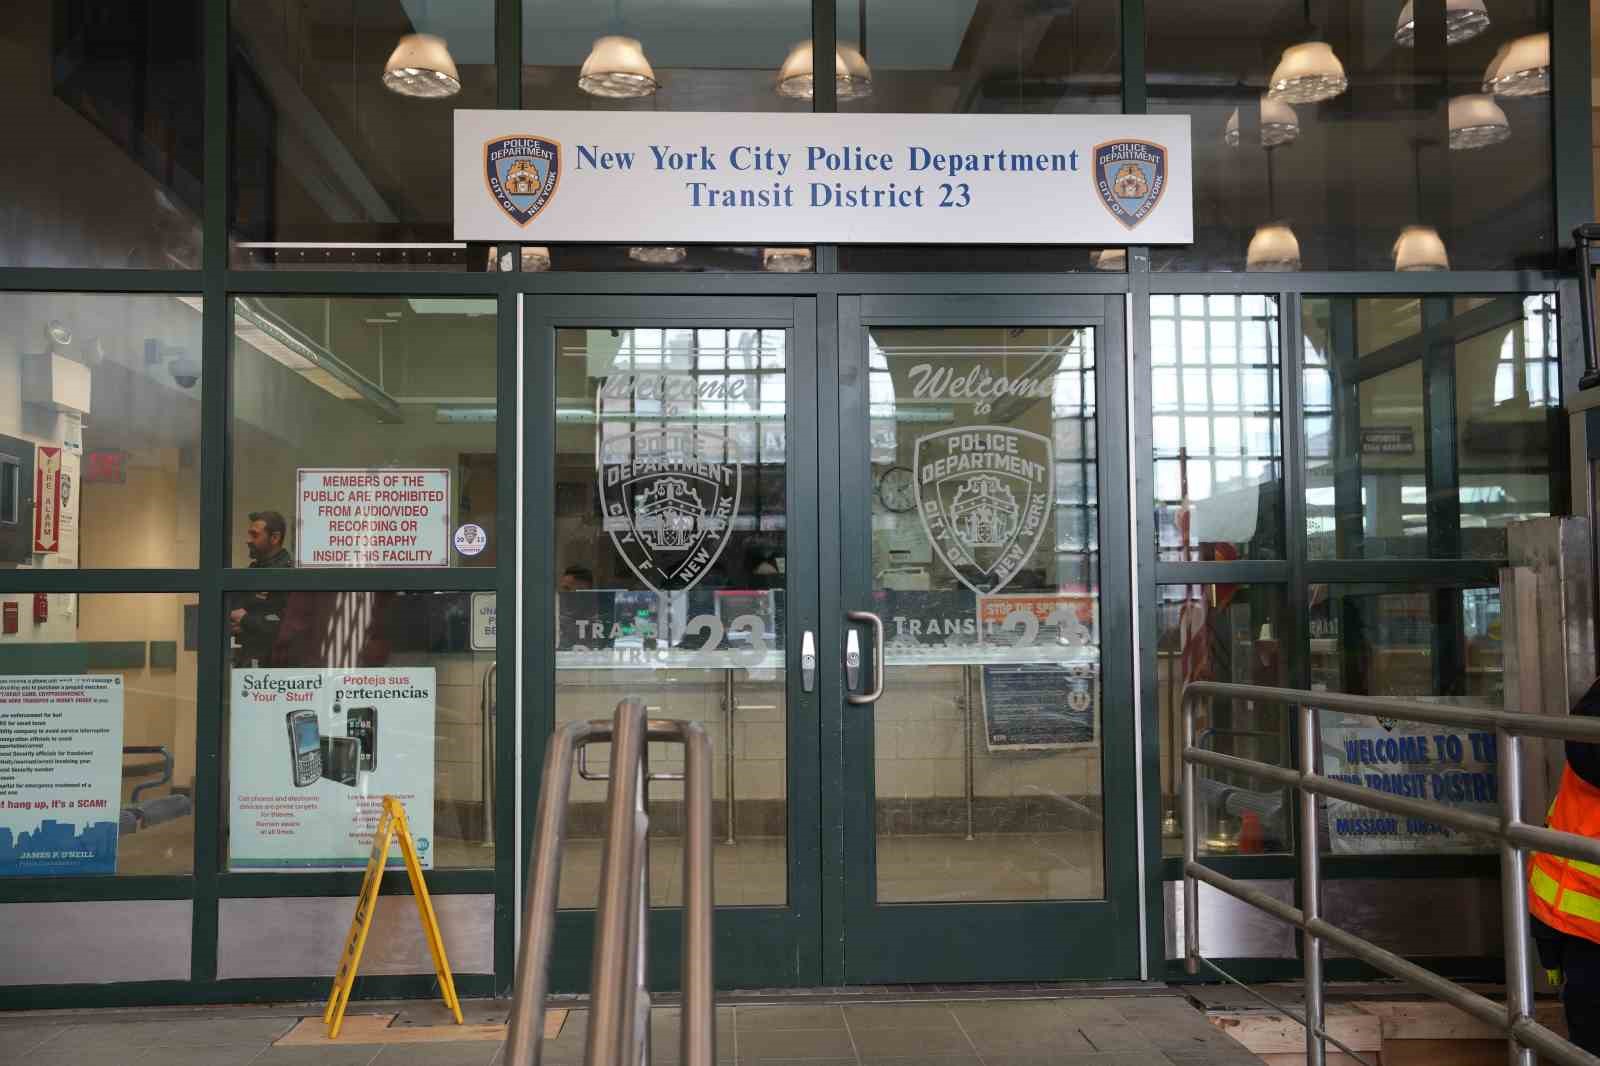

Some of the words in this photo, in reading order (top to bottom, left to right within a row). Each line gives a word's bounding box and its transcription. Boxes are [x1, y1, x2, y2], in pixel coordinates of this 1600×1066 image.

[503, 138, 541, 149] POLICE
[1111, 144, 1147, 153] POLICE
[490, 147, 554, 161] DEPARTMENT
[576, 145, 635, 170] New
[648, 146, 717, 170] York
[729, 145, 792, 176] City
[807, 146, 893, 171] Police
[909, 146, 1079, 177] Department
[1099, 151, 1162, 165] DEPARTMENT
[489, 177, 506, 203] CITY
[502, 199, 517, 213] OF
[527, 196, 546, 217] NEW
[540, 171, 558, 200] YORK
[686, 182, 793, 207] Transit
[809, 182, 924, 208] District
[938, 183, 971, 208] 23
[1098, 180, 1115, 206] CITY
[1111, 202, 1125, 216] OF
[1135, 198, 1154, 219] NEW
[1149, 175, 1164, 202] YORK
[908, 364, 1055, 399] Welcome
[974, 401, 991, 416] to
[948, 434, 1018, 454] POLICE
[607, 458, 734, 487] DEPARTMENT
[922, 453, 1045, 484] DEPARTMENT
[323, 475, 380, 487] MEMBERS
[384, 475, 399, 487] OF
[402, 475, 424, 487] THE
[304, 490, 345, 502] PUBLIC
[349, 490, 371, 502] ARE
[375, 490, 444, 502] PROHIBITED
[319, 505, 350, 517] FROM
[355, 505, 428, 517] AUDIO/VIDEO
[329, 520, 397, 532] RECORDING
[401, 520, 417, 532] OR
[329, 535, 417, 547] PHOTOGRAPHY
[923, 499, 951, 540] CITY
[947, 546, 969, 567] OF
[995, 543, 1024, 579] NEW
[1021, 493, 1046, 537] YORK
[313, 550, 349, 562] INSIDE
[355, 550, 380, 562] THIS
[383, 550, 433, 562] FACILITY
[680, 549, 711, 583] NEW
[893, 616, 997, 636] TRANSIT
[687, 614, 769, 666] 23
[243, 674, 323, 693] Safeguard
[343, 675, 386, 687] Proteja
[387, 677, 410, 685] sus
[251, 692, 277, 702] Your
[286, 691, 314, 701] Stuff
[335, 686, 429, 702] pertenencias
[1344, 736, 1428, 765] WELCOME
[1433, 734, 1464, 764] TO
[8, 800, 31, 810] hang
[77, 799, 107, 809] SCAM!
